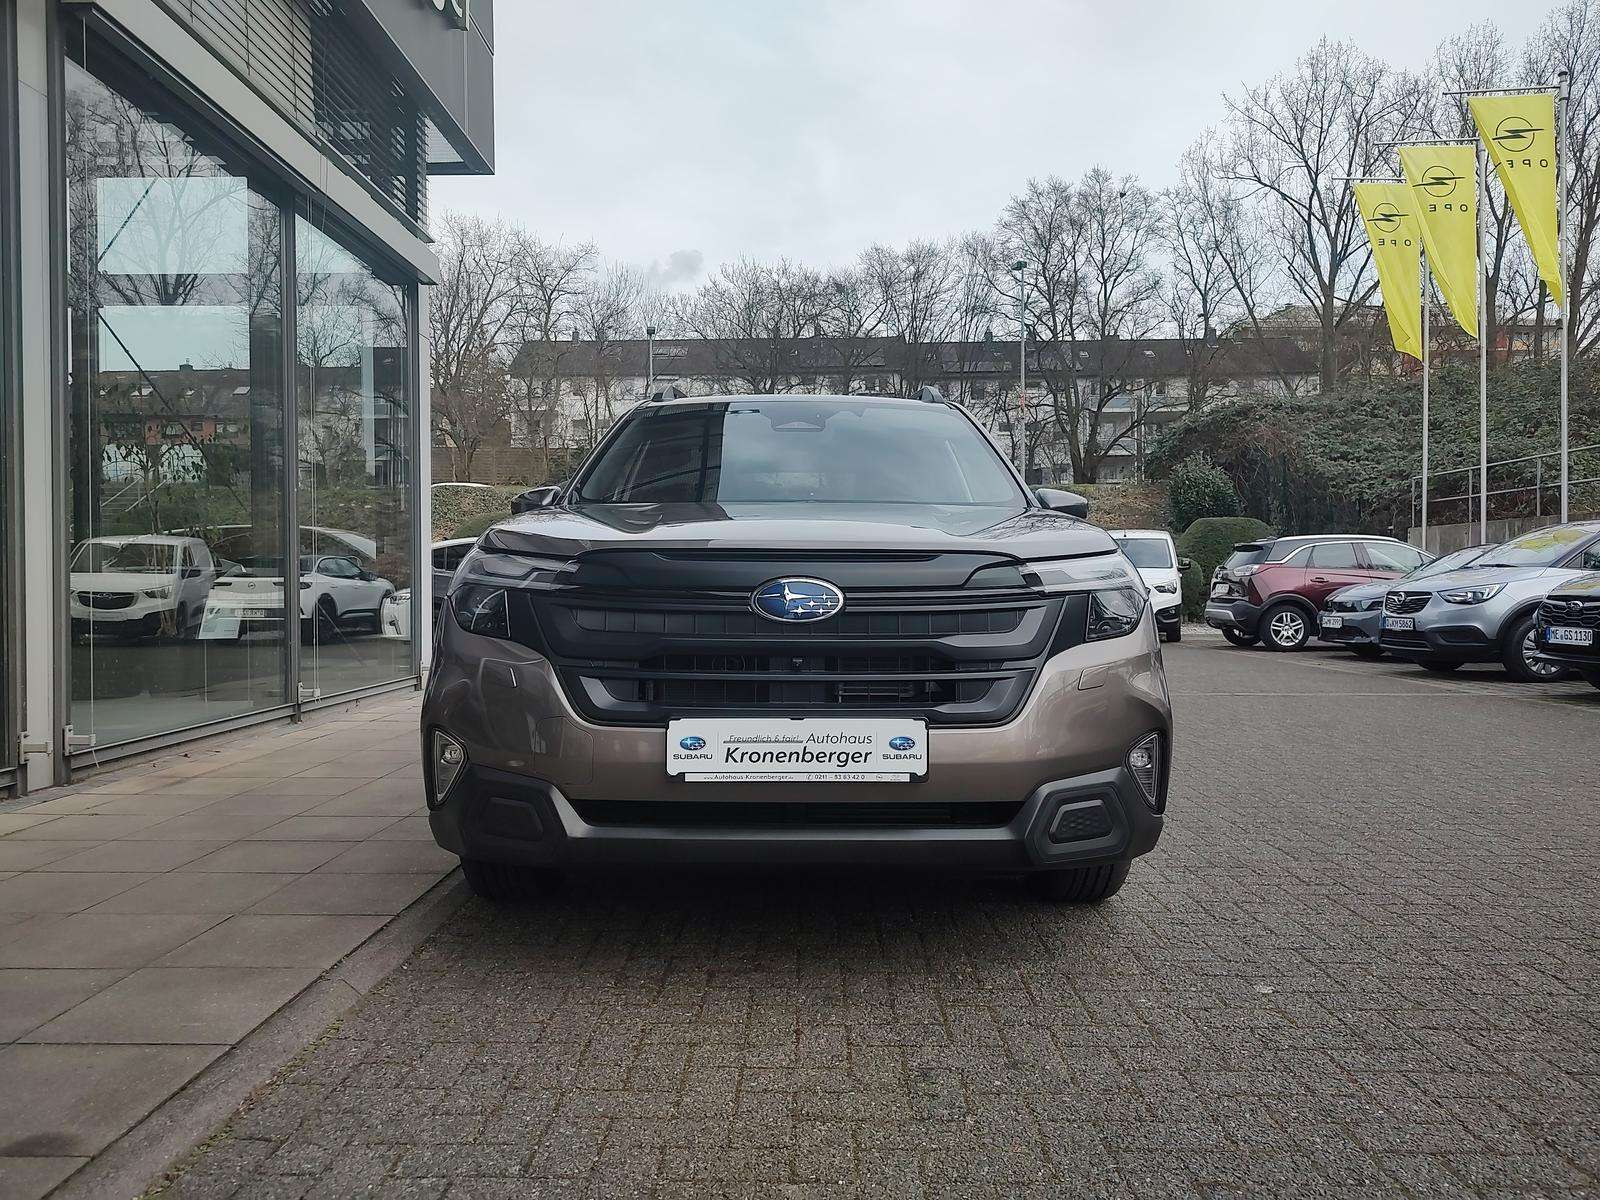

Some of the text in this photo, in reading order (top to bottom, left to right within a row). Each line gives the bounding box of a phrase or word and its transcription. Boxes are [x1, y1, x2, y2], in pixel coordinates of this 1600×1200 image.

[1574, 629, 1592, 642] 1130
[729, 731, 873, 745] Freundlich & fair! Autohaus
[724, 746, 873, 767] Kronenberger
